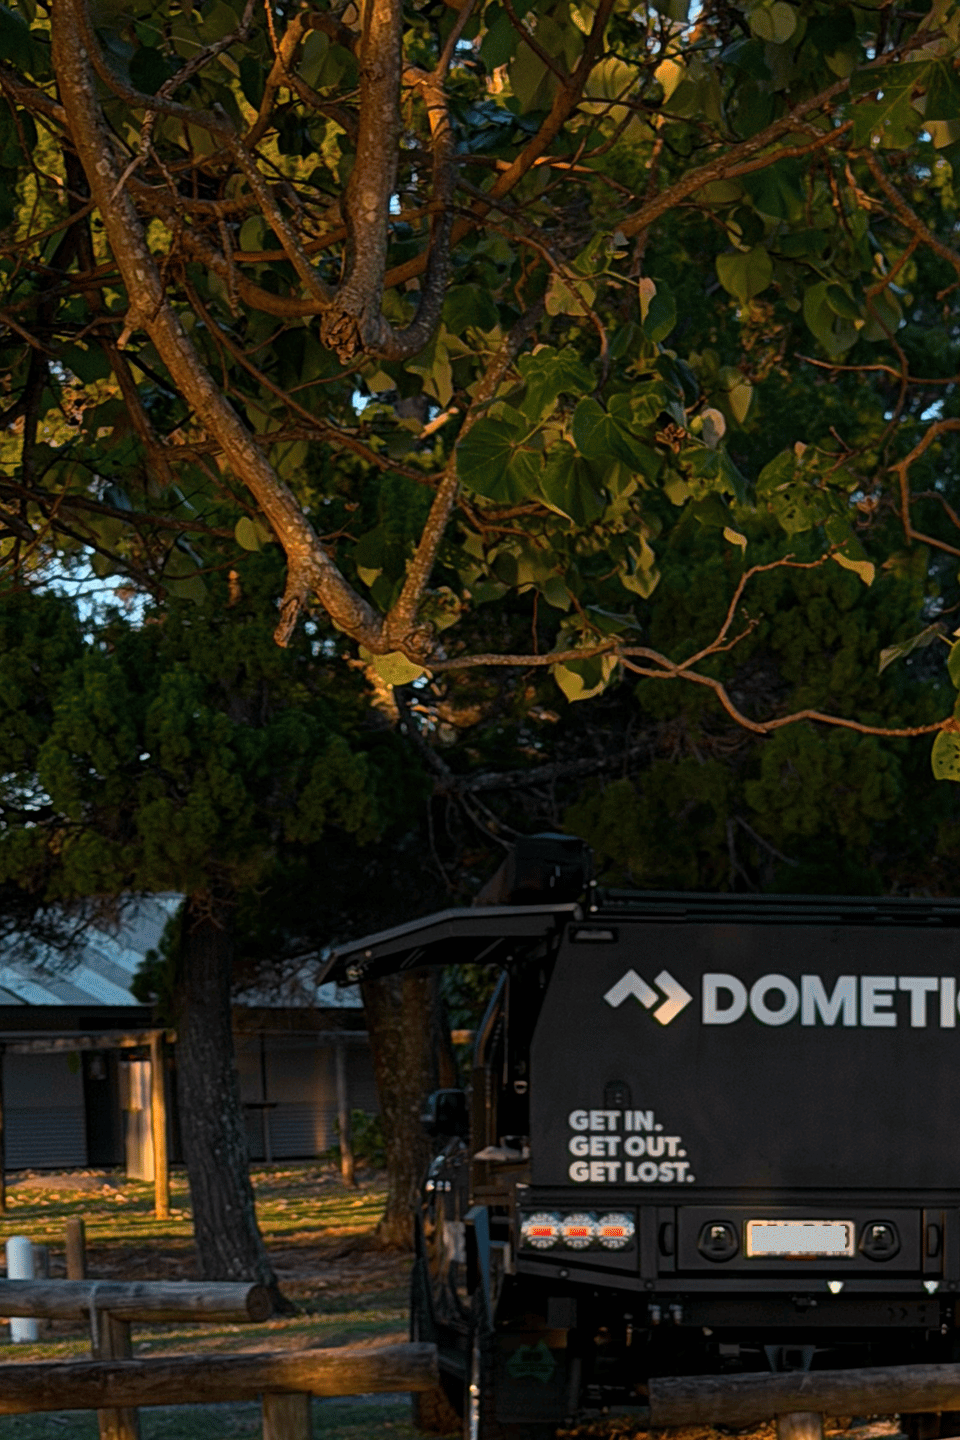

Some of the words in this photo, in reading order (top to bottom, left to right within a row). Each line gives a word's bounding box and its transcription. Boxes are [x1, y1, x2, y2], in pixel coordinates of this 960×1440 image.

[568, 1109, 621, 1132] GET
[623, 1110, 664, 1132] IN.
[568, 1135, 622, 1157] GET
[623, 1135, 687, 1158] OUT.
[568, 1160, 622, 1183] GET
[624, 1161, 696, 1184] LOST.
